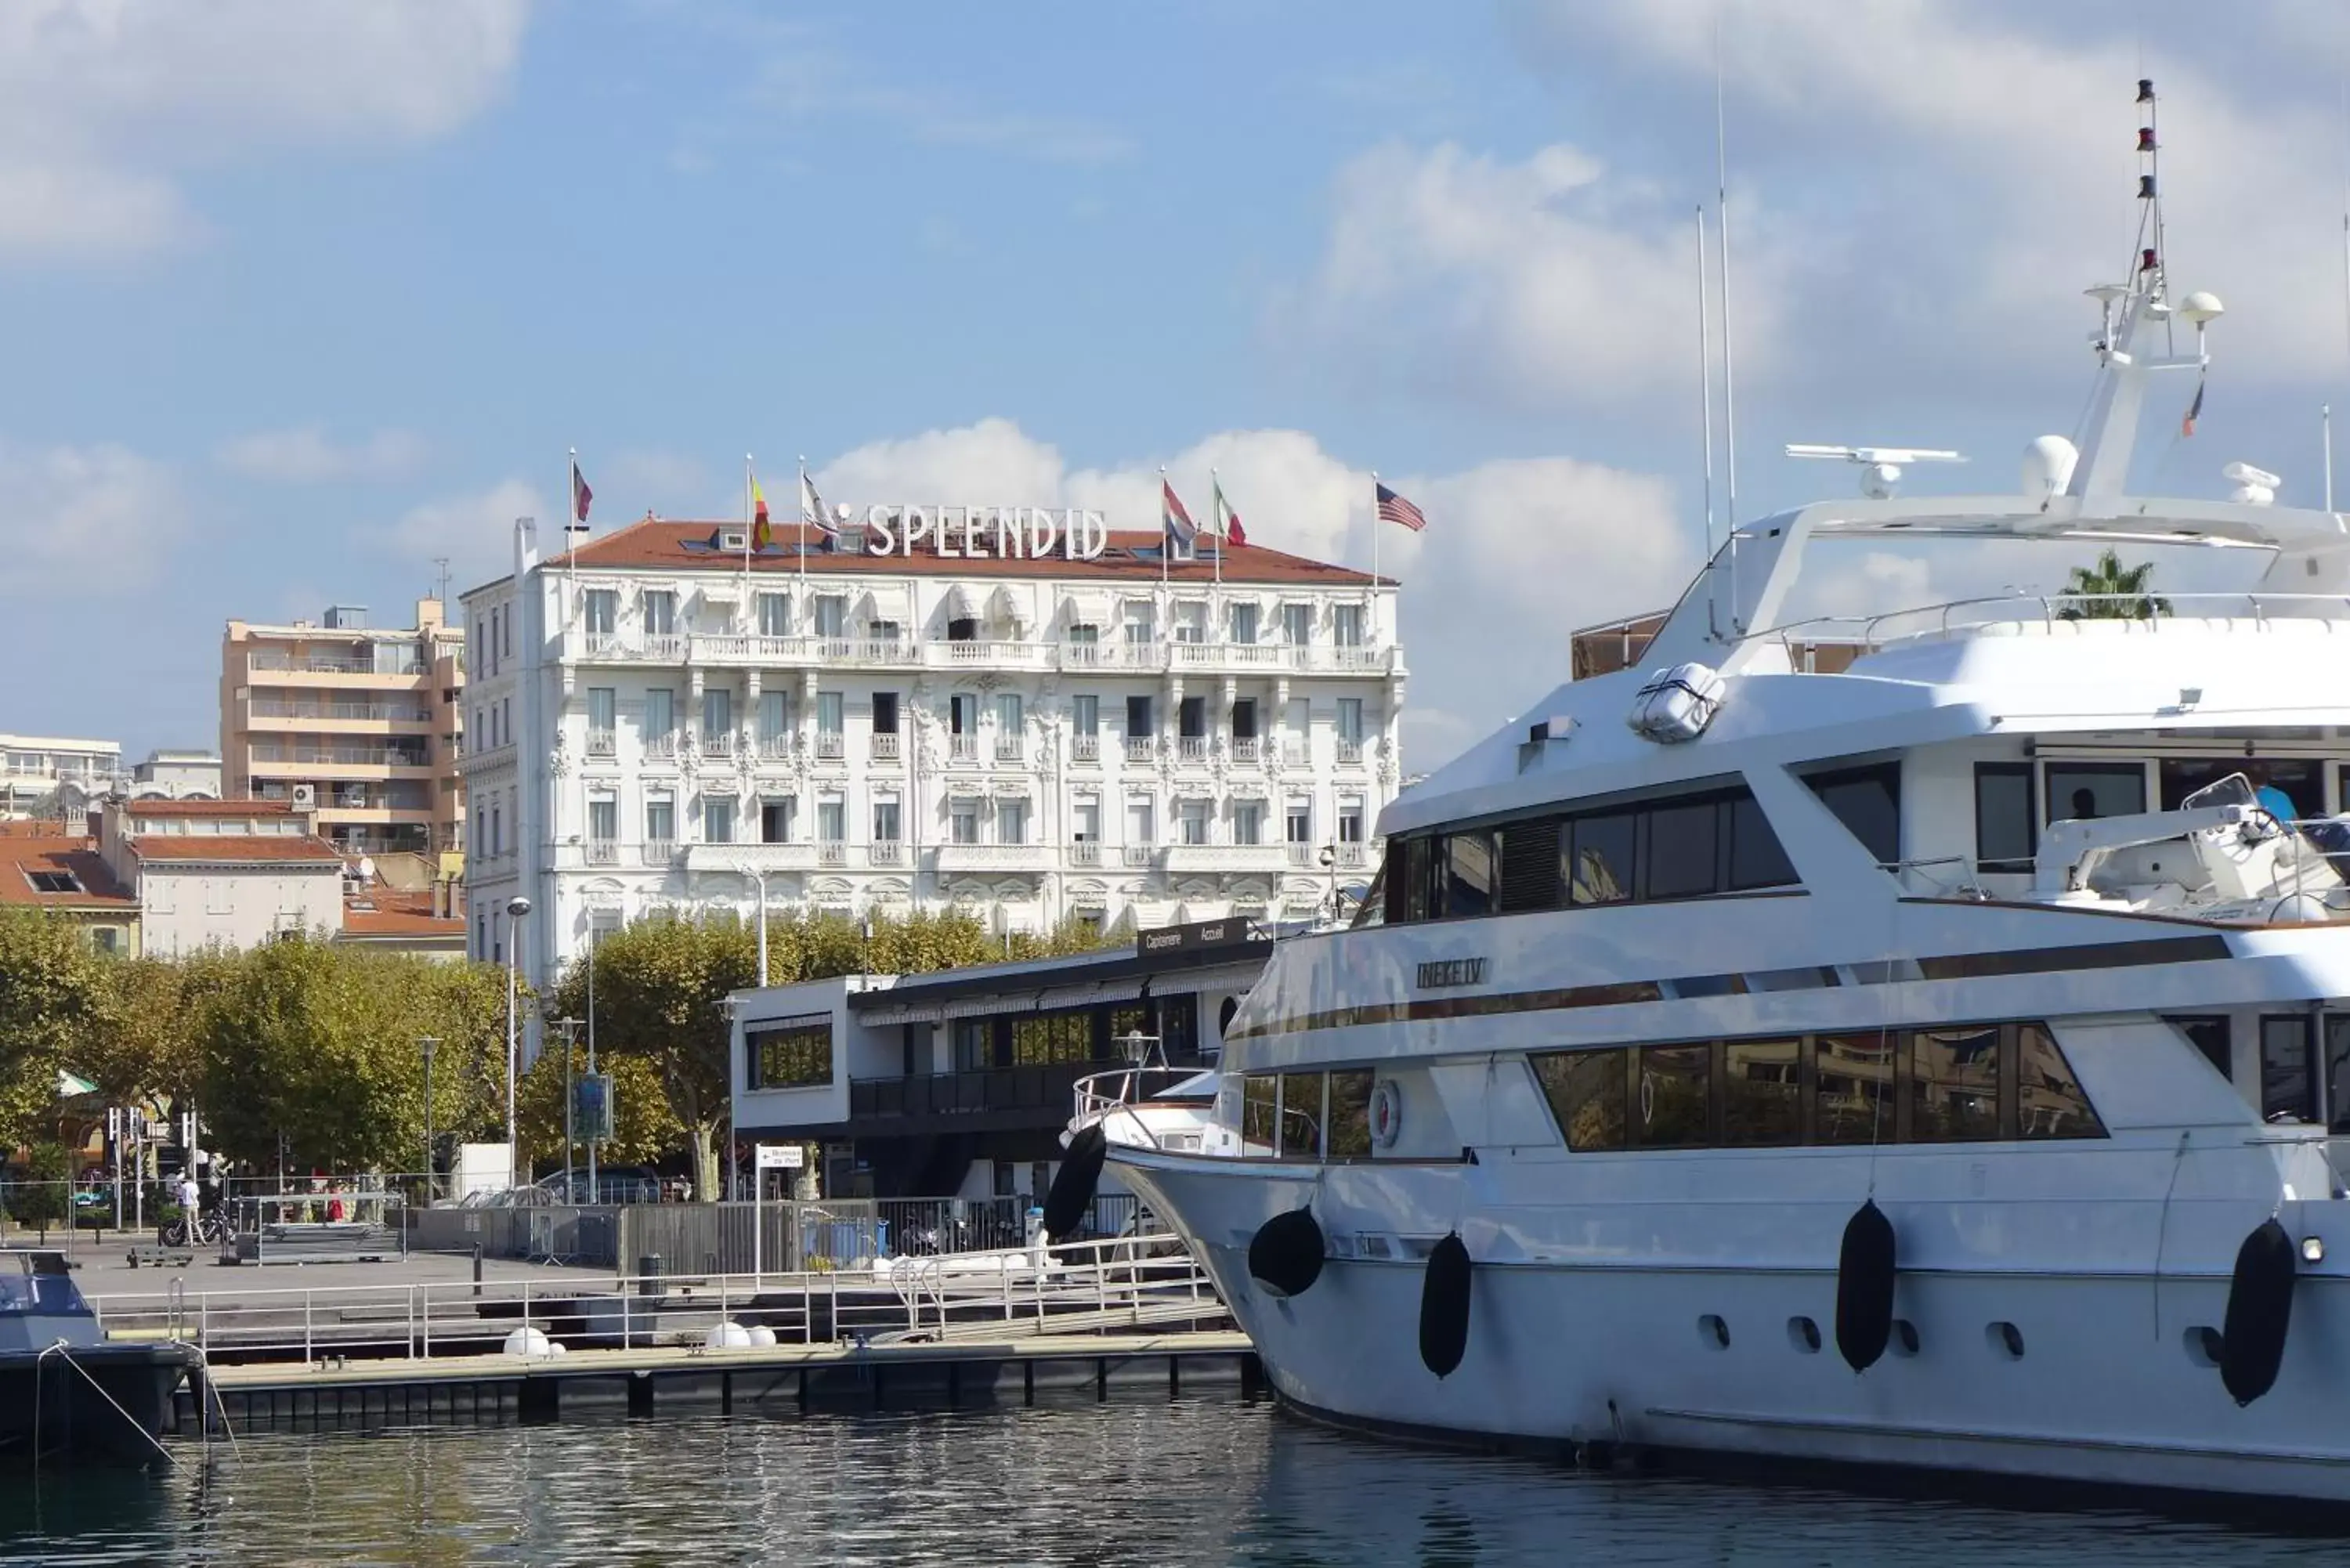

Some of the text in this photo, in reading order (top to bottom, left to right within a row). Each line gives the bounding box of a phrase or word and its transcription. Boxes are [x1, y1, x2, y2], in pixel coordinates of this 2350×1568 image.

[867, 504, 1107, 560] SPLENDID
[1201, 924, 1224, 941] Accueil
[1416, 957, 1485, 989] INEKE IV
